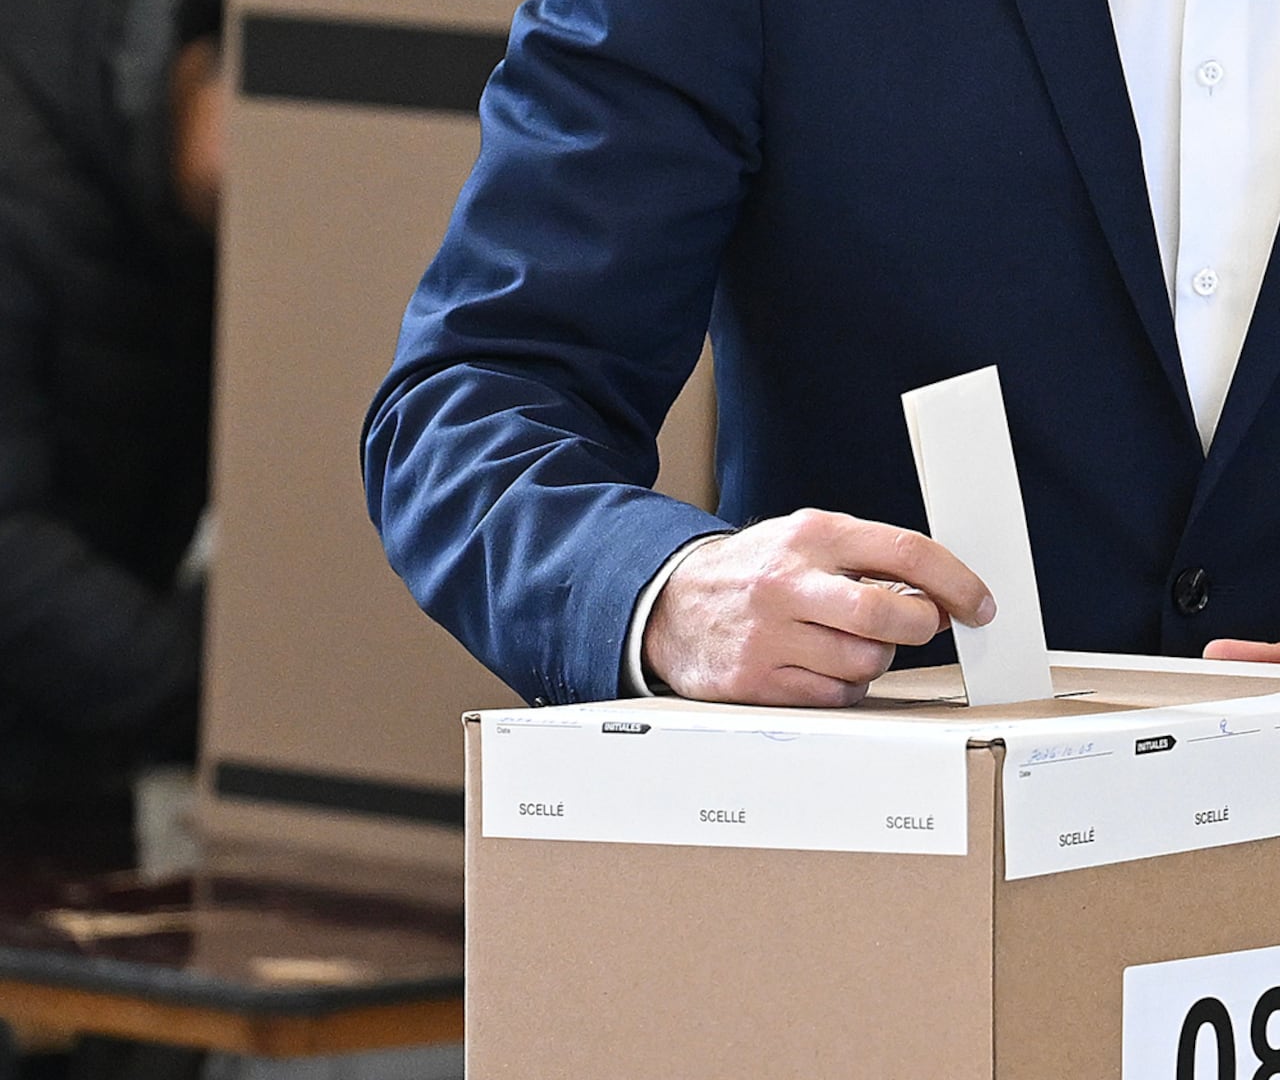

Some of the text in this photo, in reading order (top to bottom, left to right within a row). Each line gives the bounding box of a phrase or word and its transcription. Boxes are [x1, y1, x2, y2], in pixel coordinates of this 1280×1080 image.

[497, 726, 511, 735] Date
[519, 801, 565, 818] SCELLÉ
[699, 808, 746, 824] SCELLÉ
[1194, 805, 1230, 826] SCELLÉ
[886, 814, 936, 831] SCELLÉ
[1058, 826, 1096, 848] SCELLÉ
